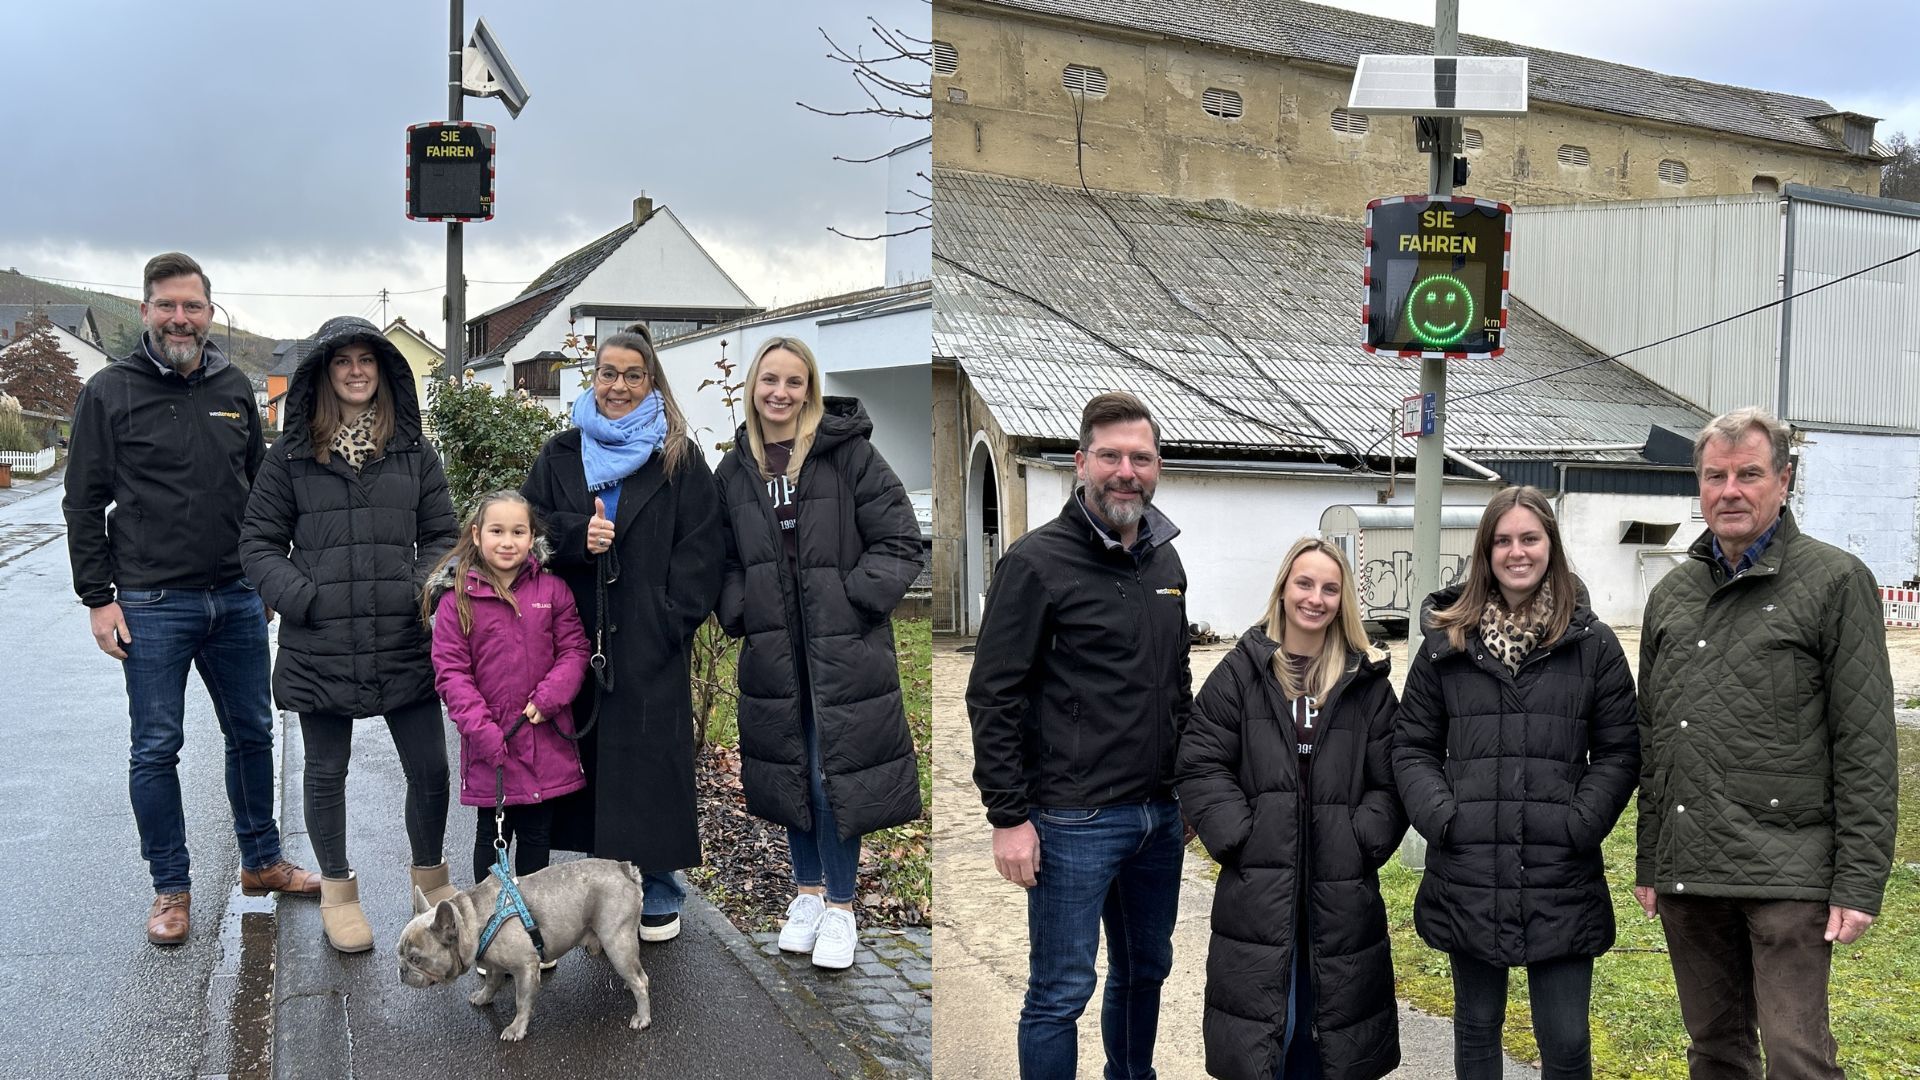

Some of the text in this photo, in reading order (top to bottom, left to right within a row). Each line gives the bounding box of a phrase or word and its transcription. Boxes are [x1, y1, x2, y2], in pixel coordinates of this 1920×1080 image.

[440, 130, 461, 142] SIE
[426, 146, 474, 157] FAHREN
[1423, 210, 1455, 228] SIE
[1399, 234, 1477, 254] FAHREN
[1484, 316, 1500, 328] km
[1488, 333, 1495, 343] h
